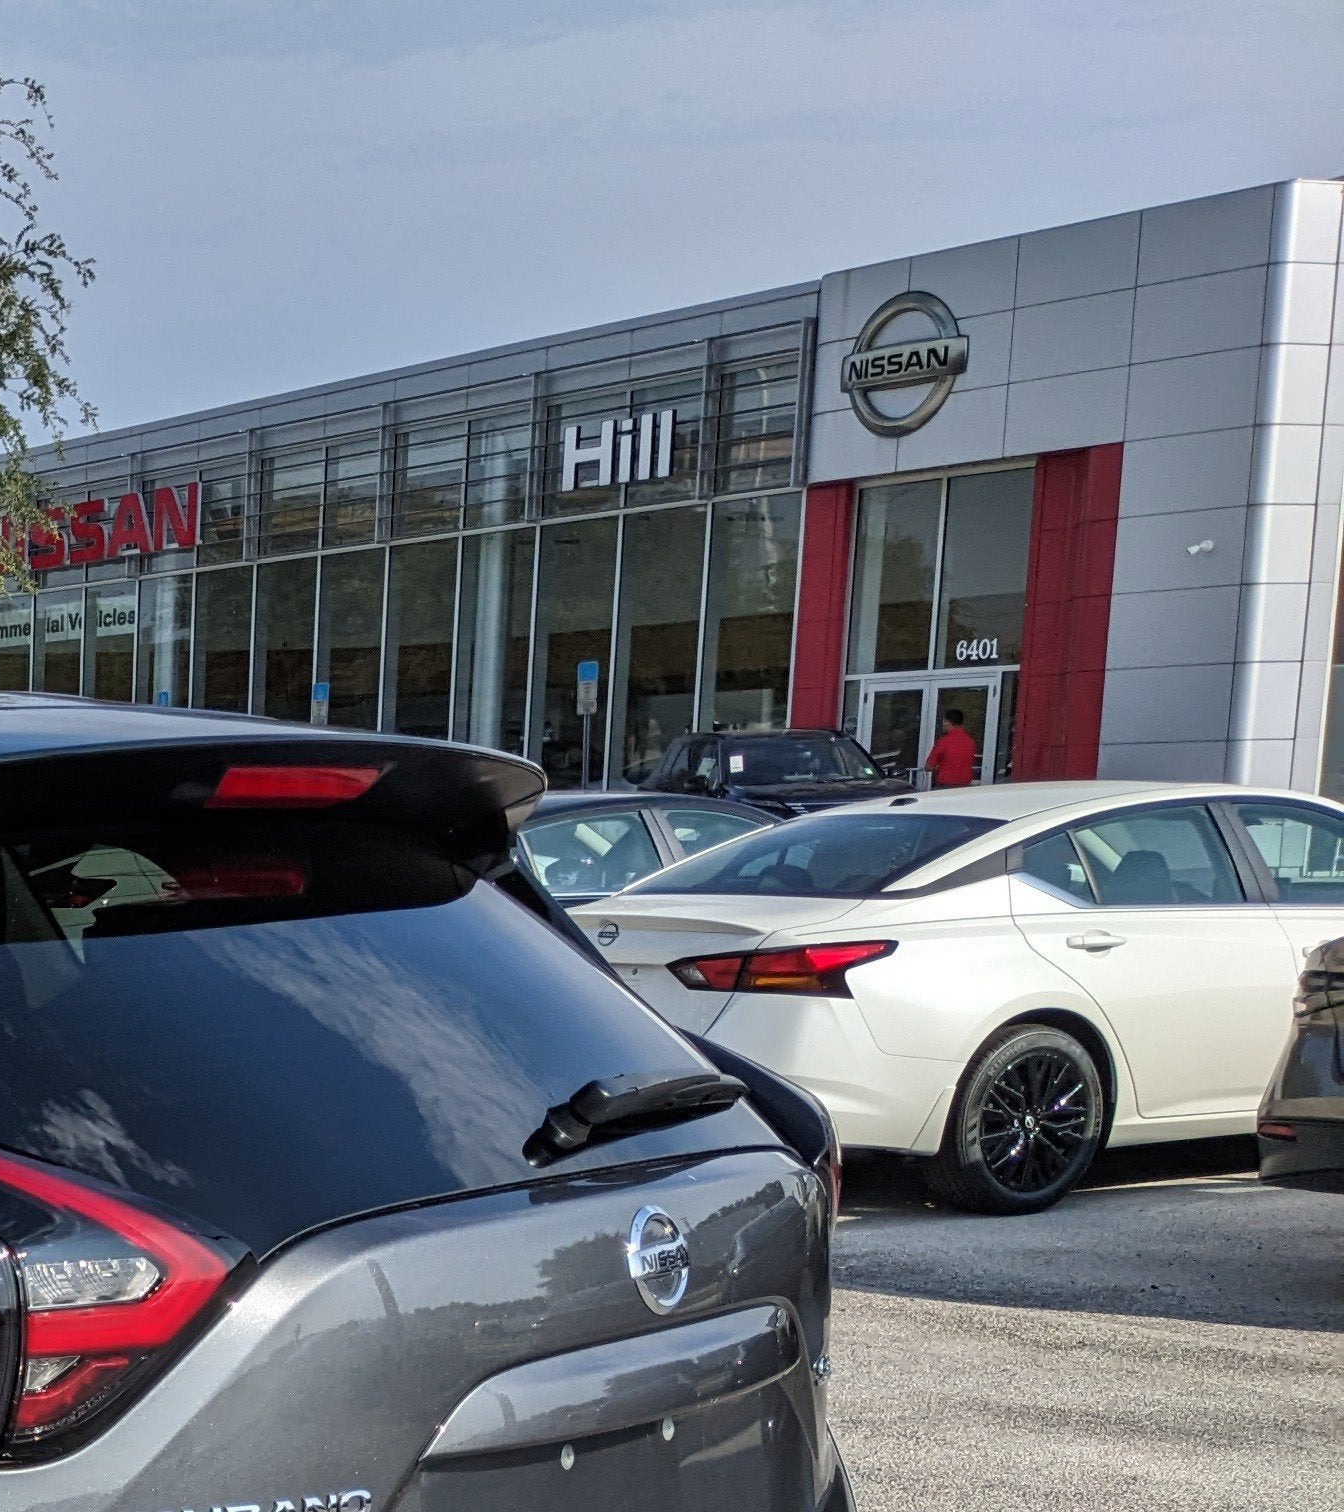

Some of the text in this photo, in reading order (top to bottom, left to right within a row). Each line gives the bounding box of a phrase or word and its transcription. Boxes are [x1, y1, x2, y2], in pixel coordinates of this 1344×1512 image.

[848, 345, 949, 382] NISSAN
[562, 408, 676, 492] Hill
[956, 637, 998, 660] 6401
